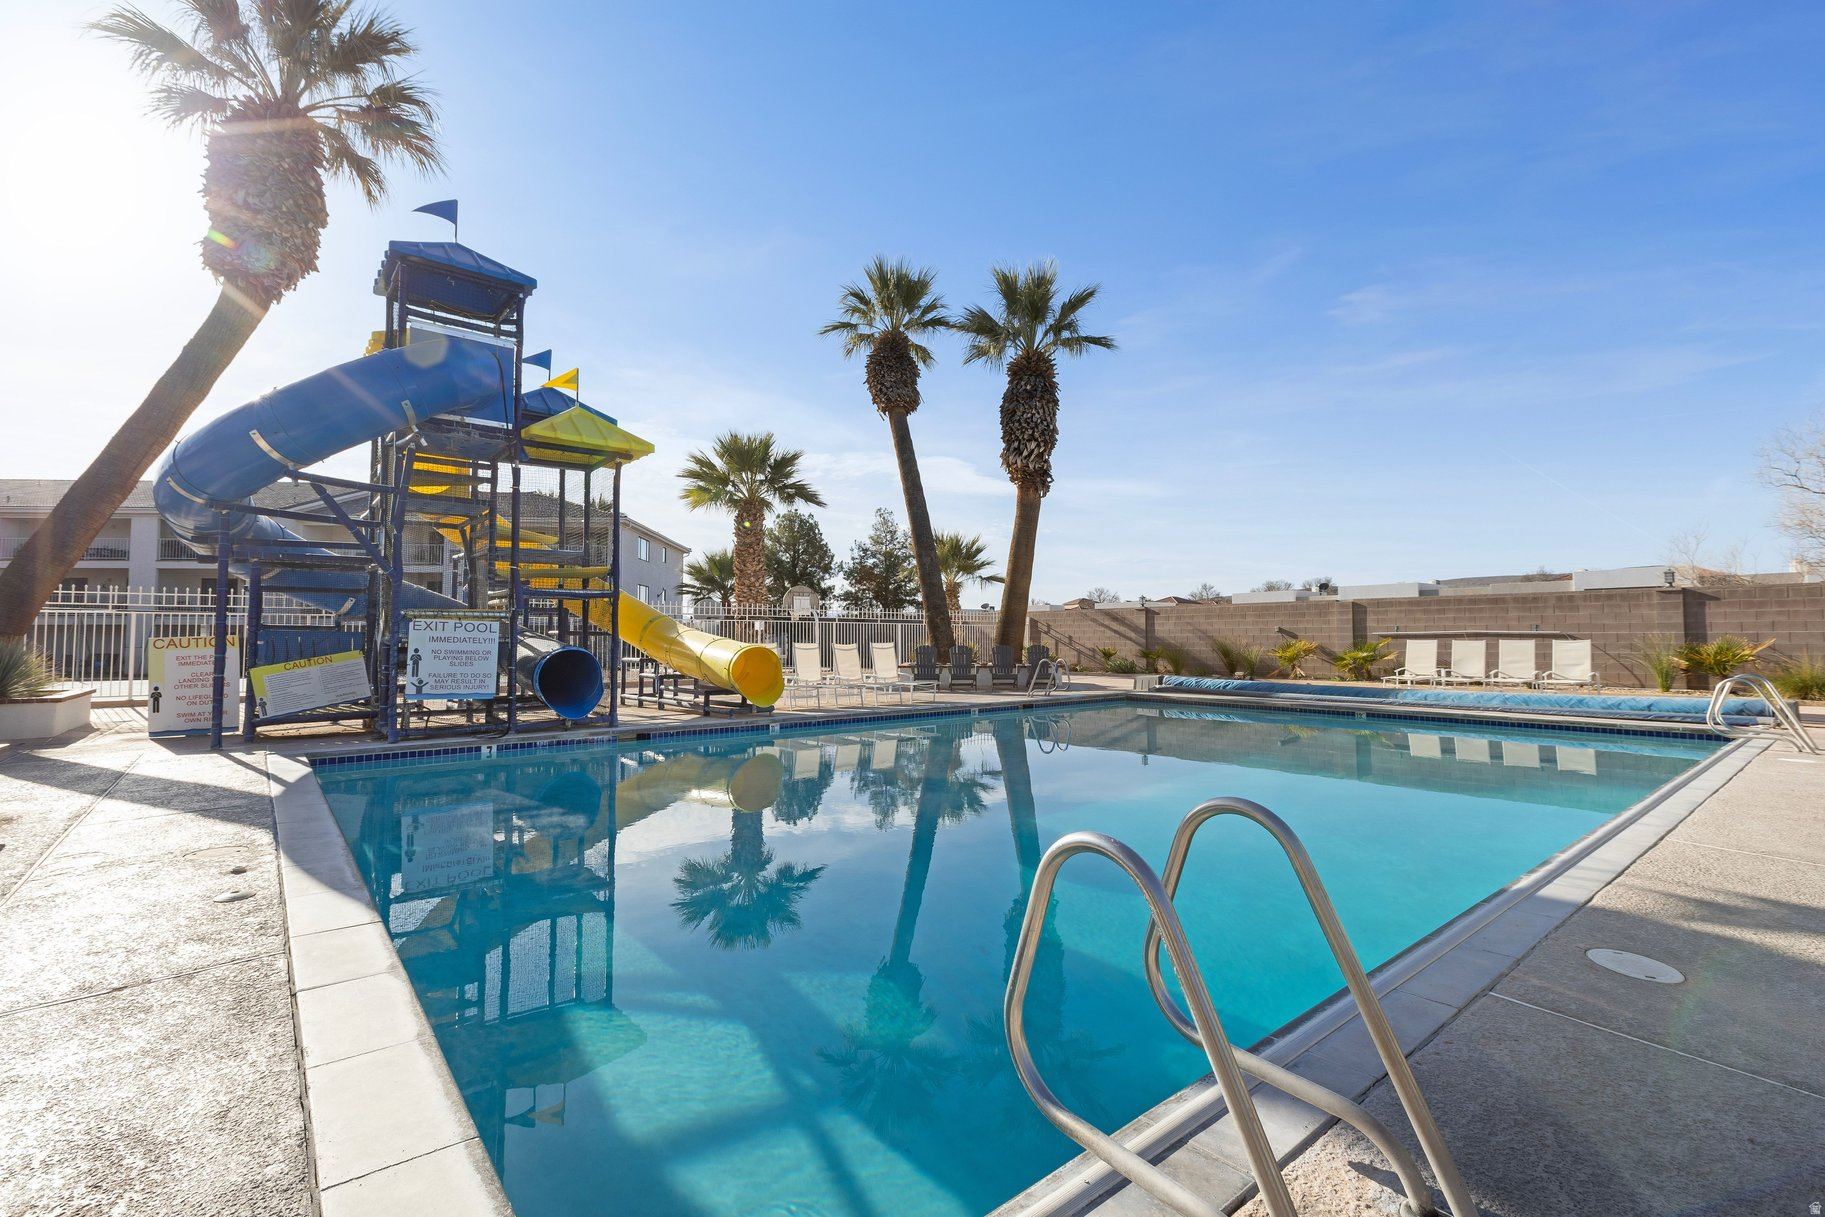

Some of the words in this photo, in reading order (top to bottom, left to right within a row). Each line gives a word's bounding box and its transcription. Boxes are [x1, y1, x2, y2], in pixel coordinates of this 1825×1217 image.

[412, 620, 449, 631] EXIT
[453, 622, 497, 634] POOL
[428, 636, 496, 644] IMMEDIATELY!!!
[283, 656, 333, 671] CAUTION
